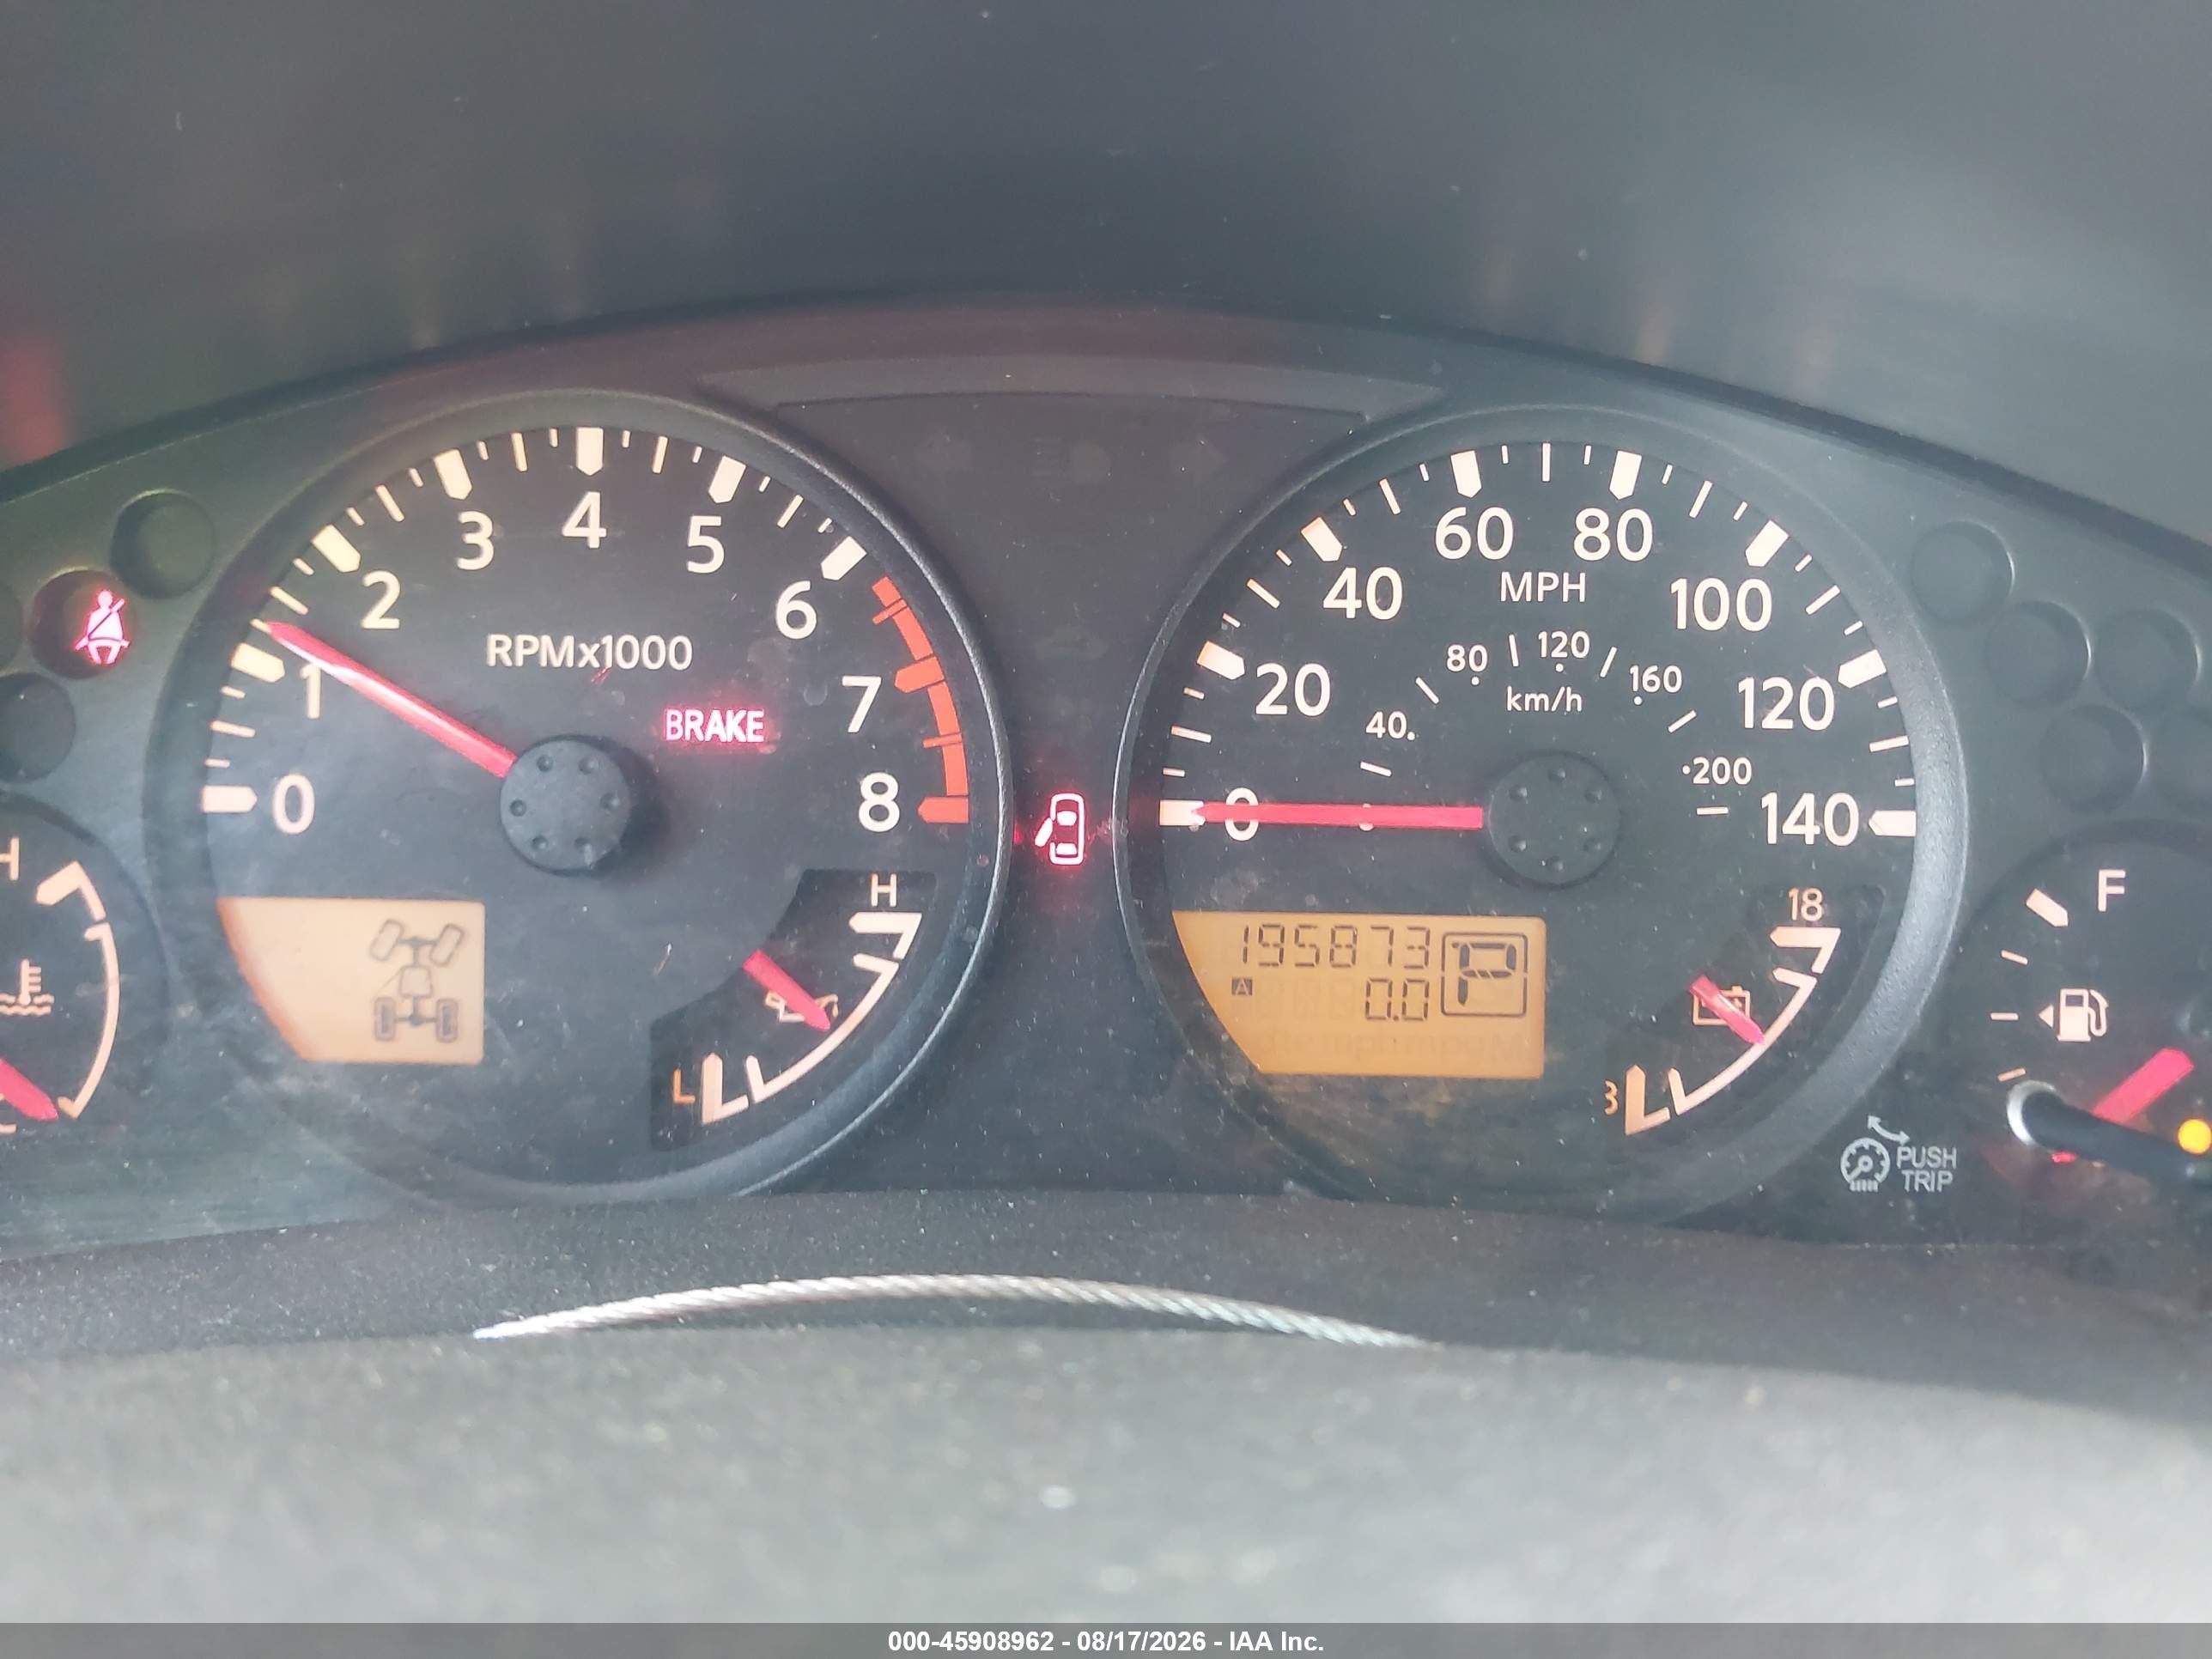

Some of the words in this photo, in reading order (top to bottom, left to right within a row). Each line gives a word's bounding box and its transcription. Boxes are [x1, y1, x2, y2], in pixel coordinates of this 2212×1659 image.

[455, 510, 495, 571] 3
[561, 489, 607, 550] 4
[685, 514, 726, 574] 5
[1434, 506, 1515, 562] 60
[1571, 507, 1653, 563] 80
[361, 568, 402, 630] 2
[774, 579, 818, 640] 6
[1321, 565, 1404, 622] 40
[1498, 570, 1587, 604] MPH
[1669, 576, 1773, 633] 100
[483, 633, 694, 672] RPMx1000
[1445, 642, 1489, 673] 80
[1536, 629, 1591, 660] 120
[300, 663, 322, 719] 1
[840, 674, 883, 734] 7
[1254, 661, 1332, 717] 20
[1504, 684, 1583, 714] km/h
[1628, 664, 1684, 694] 160
[1736, 675, 1836, 731] 120
[664, 707, 766, 744] BRAKE
[270, 772, 316, 836] 0
[857, 771, 901, 833] 8
[1223, 786, 1261, 842] 0
[1759, 791, 1860, 847] 140
[871, 873, 897, 906] H
[1786, 887, 1824, 922] 18
[2097, 868, 2127, 913] F
[1242, 924, 1431, 968] 195873
[1364, 976, 1431, 1022] 0.0
[1452, 942, 1517, 1007] P
[672, 1070, 696, 1104] L
[1895, 1145, 1958, 1170] PUSH
[1900, 1169, 1954, 1194] TRIP
